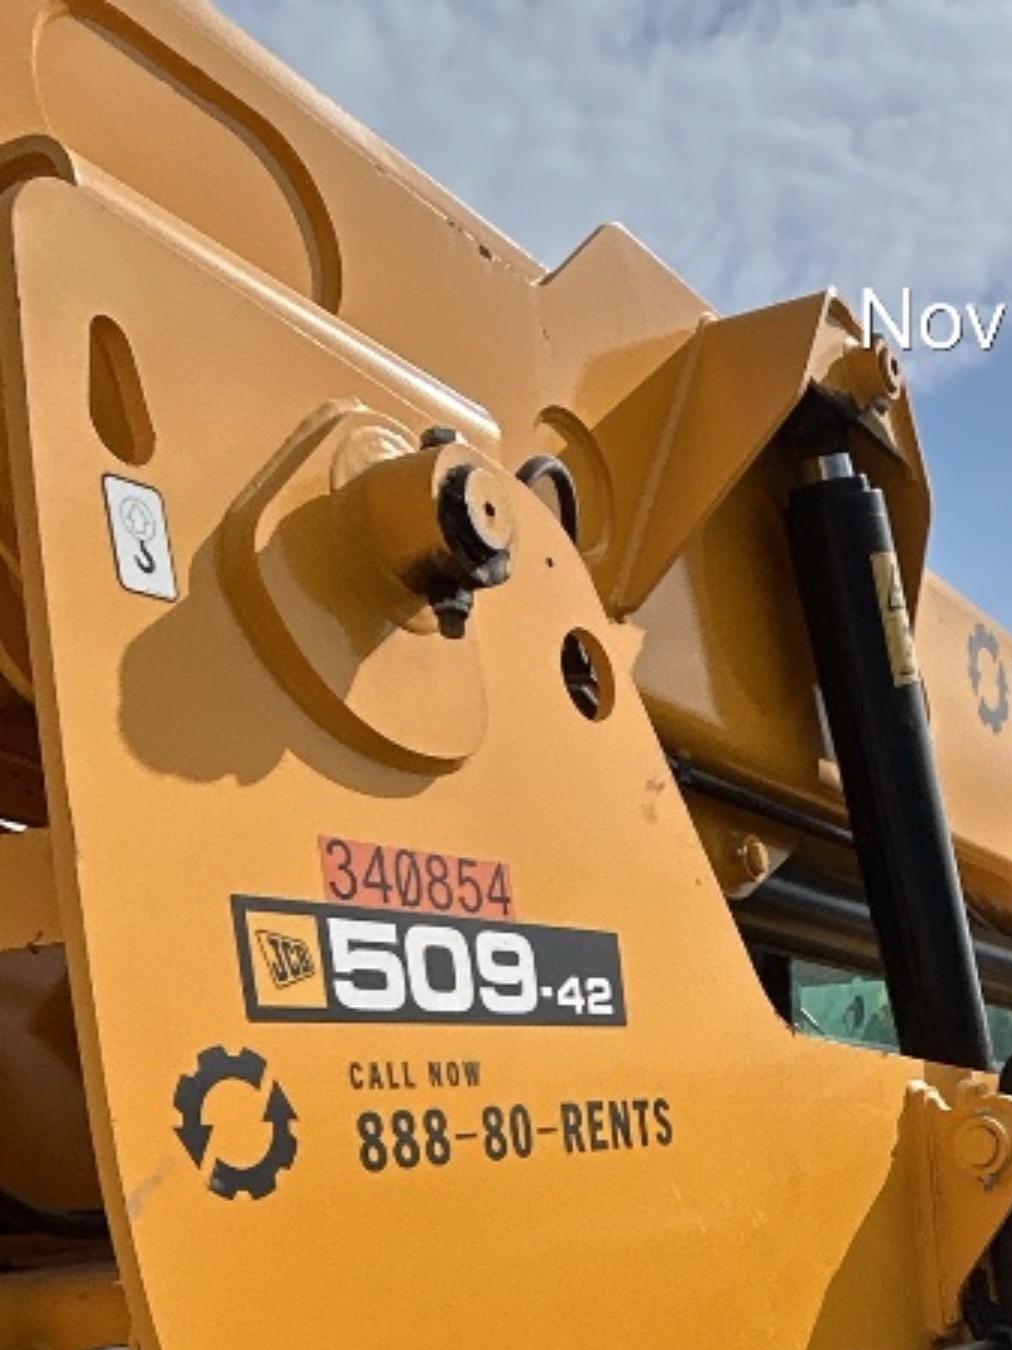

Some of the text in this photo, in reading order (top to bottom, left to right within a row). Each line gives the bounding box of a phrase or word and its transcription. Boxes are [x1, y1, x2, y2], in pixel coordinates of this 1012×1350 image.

[327, 838, 512, 916] 340854
[262, 931, 316, 984] JCB
[350, 1061, 481, 1090] CALL NOW
[356, 1097, 673, 1173] 888-80-RENTS
